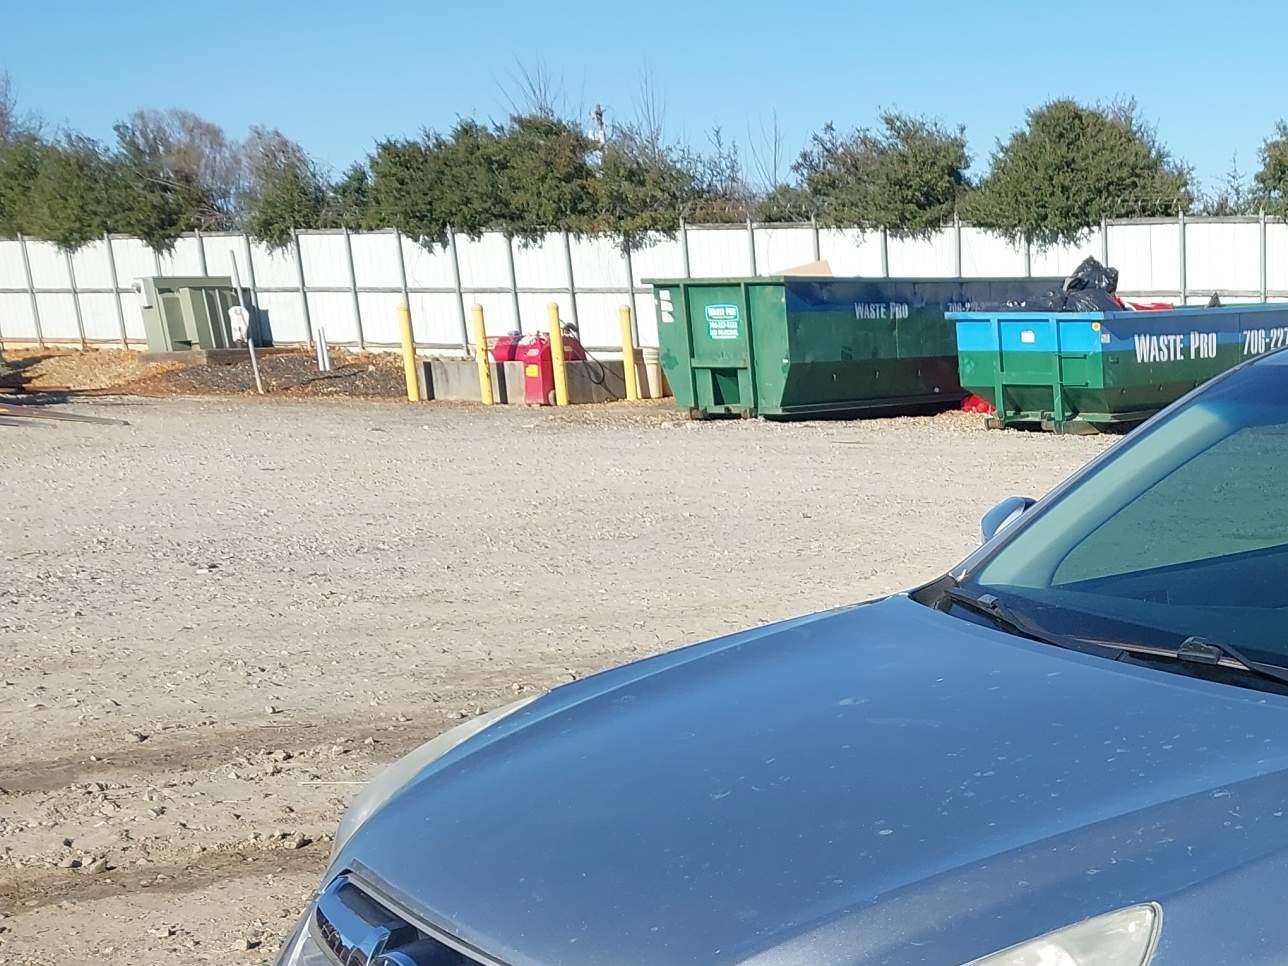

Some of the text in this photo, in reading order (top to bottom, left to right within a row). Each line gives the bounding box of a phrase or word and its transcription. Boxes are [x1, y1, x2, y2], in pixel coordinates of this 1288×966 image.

[854, 302, 887, 320] WASTE
[889, 302, 909, 320] PRO
[1134, 332, 1184, 363] WASTE
[1190, 331, 1217, 359] PRO
